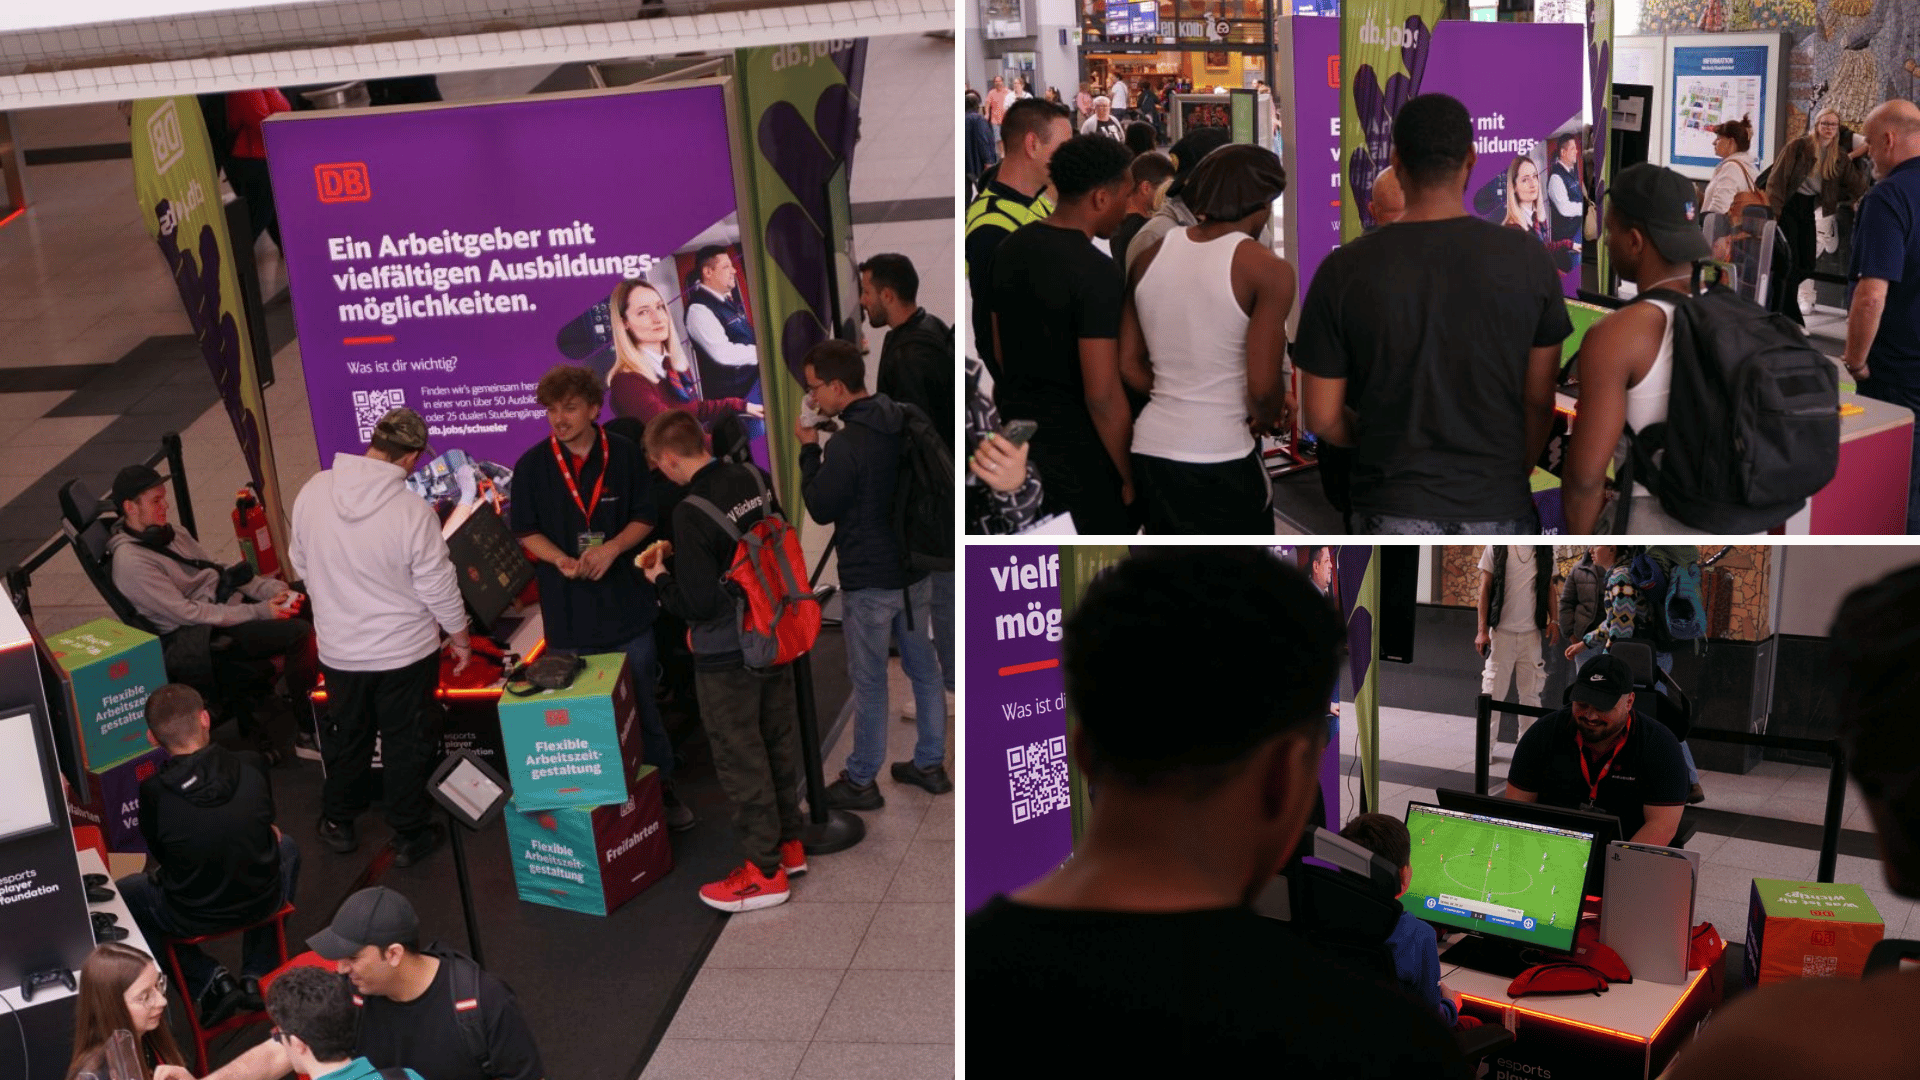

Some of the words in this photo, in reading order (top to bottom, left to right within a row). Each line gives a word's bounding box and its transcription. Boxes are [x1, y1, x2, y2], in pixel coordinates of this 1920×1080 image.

[1478, 112, 1505, 130] mit
[321, 167, 365, 197] DB
[328, 235, 372, 261] Ein
[378, 226, 541, 258] Arbeitgeber
[548, 220, 596, 246] mit
[332, 261, 481, 291] vielfältigen
[487, 252, 661, 279] Ausbildungs-
[338, 290, 537, 325] möglichkeiten.
[347, 361, 373, 374] Was
[375, 360, 390, 373] ist
[392, 359, 407, 372] dir
[410, 356, 458, 373] wichtig?
[421, 385, 450, 395] Finden
[472, 383, 519, 395] gemeinsam
[423, 400, 432, 408] in
[433, 399, 453, 408] einer
[455, 399, 472, 407] von
[494, 395, 506, 405] 50
[426, 412, 445, 422] oder
[446, 411, 458, 421] 25
[459, 410, 487, 420] dualen
[428, 422, 509, 436] db.jobs/schueler
[102, 685, 145, 708] Flexible
[1001, 702, 1032, 721] Was
[1036, 697, 1052, 714] ist
[445, 740, 473, 749] player
[535, 738, 588, 752] Flexible
[526, 750, 602, 765] Arbeitszeit-
[531, 763, 602, 780] gestaltung
[530, 839, 574, 857] Flexible
[606, 821, 660, 863] Freifahrten
[524, 850, 586, 870] Arbeitszeit-
[529, 863, 585, 884] gestaltung
[1497, 1058, 1551, 1079] esports
